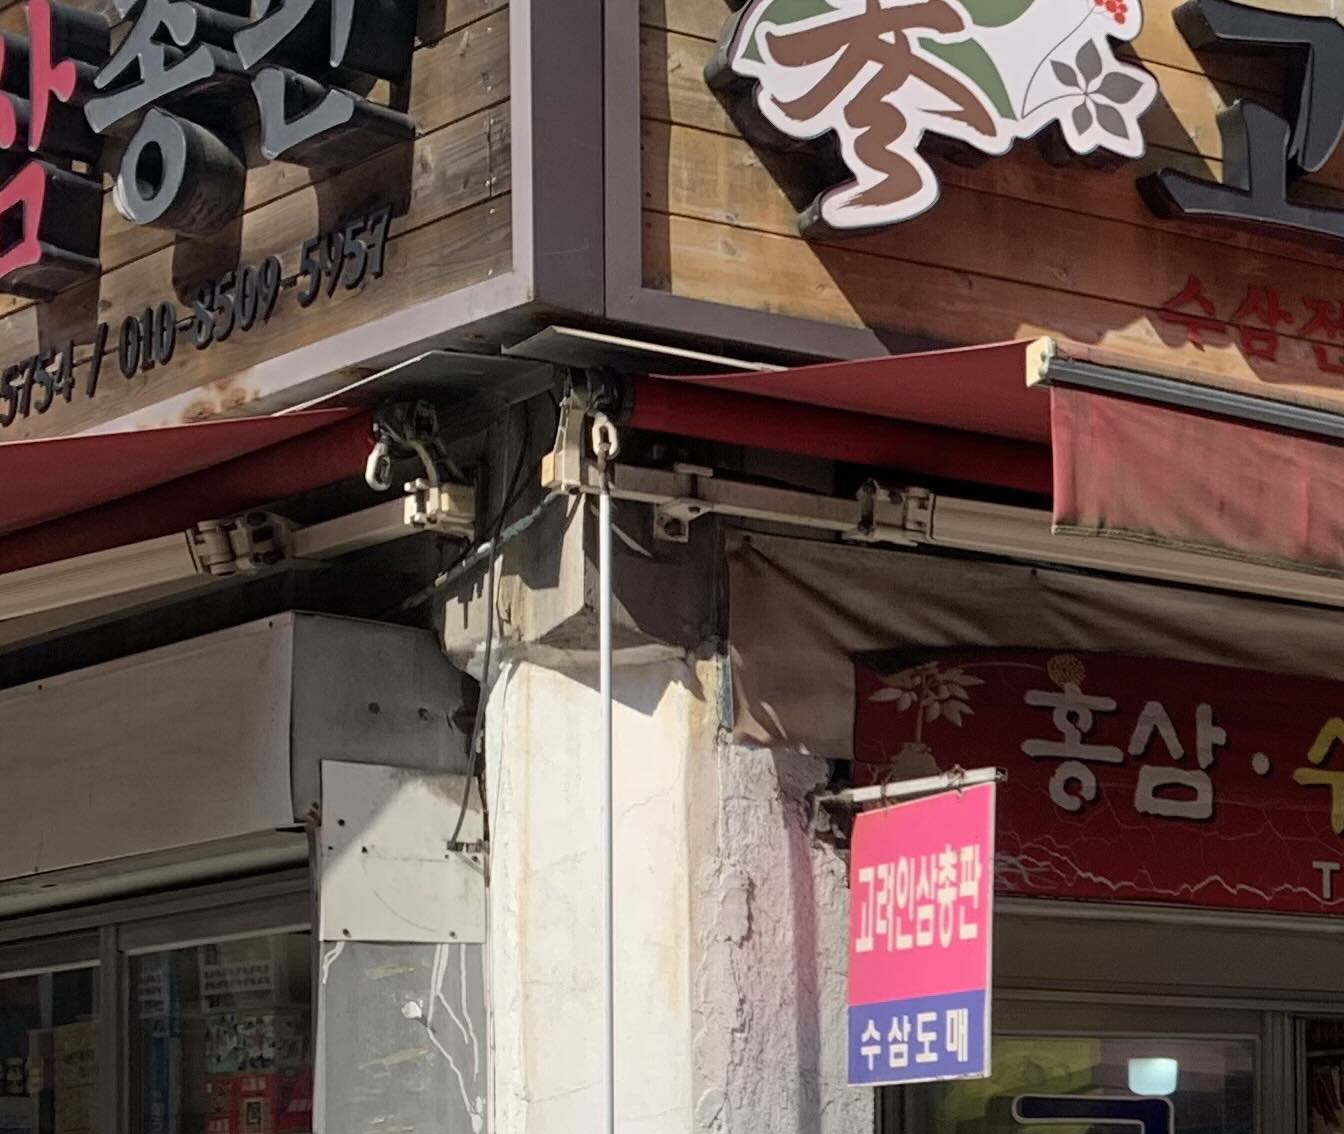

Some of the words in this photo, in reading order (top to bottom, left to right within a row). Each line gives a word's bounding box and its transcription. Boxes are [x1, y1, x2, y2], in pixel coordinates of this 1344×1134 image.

[119, 206, 393, 380] 010-8509-5957
[855, 843, 983, 953] 고려인삼총판
[861, 1007, 969, 1071] 수삼도매
